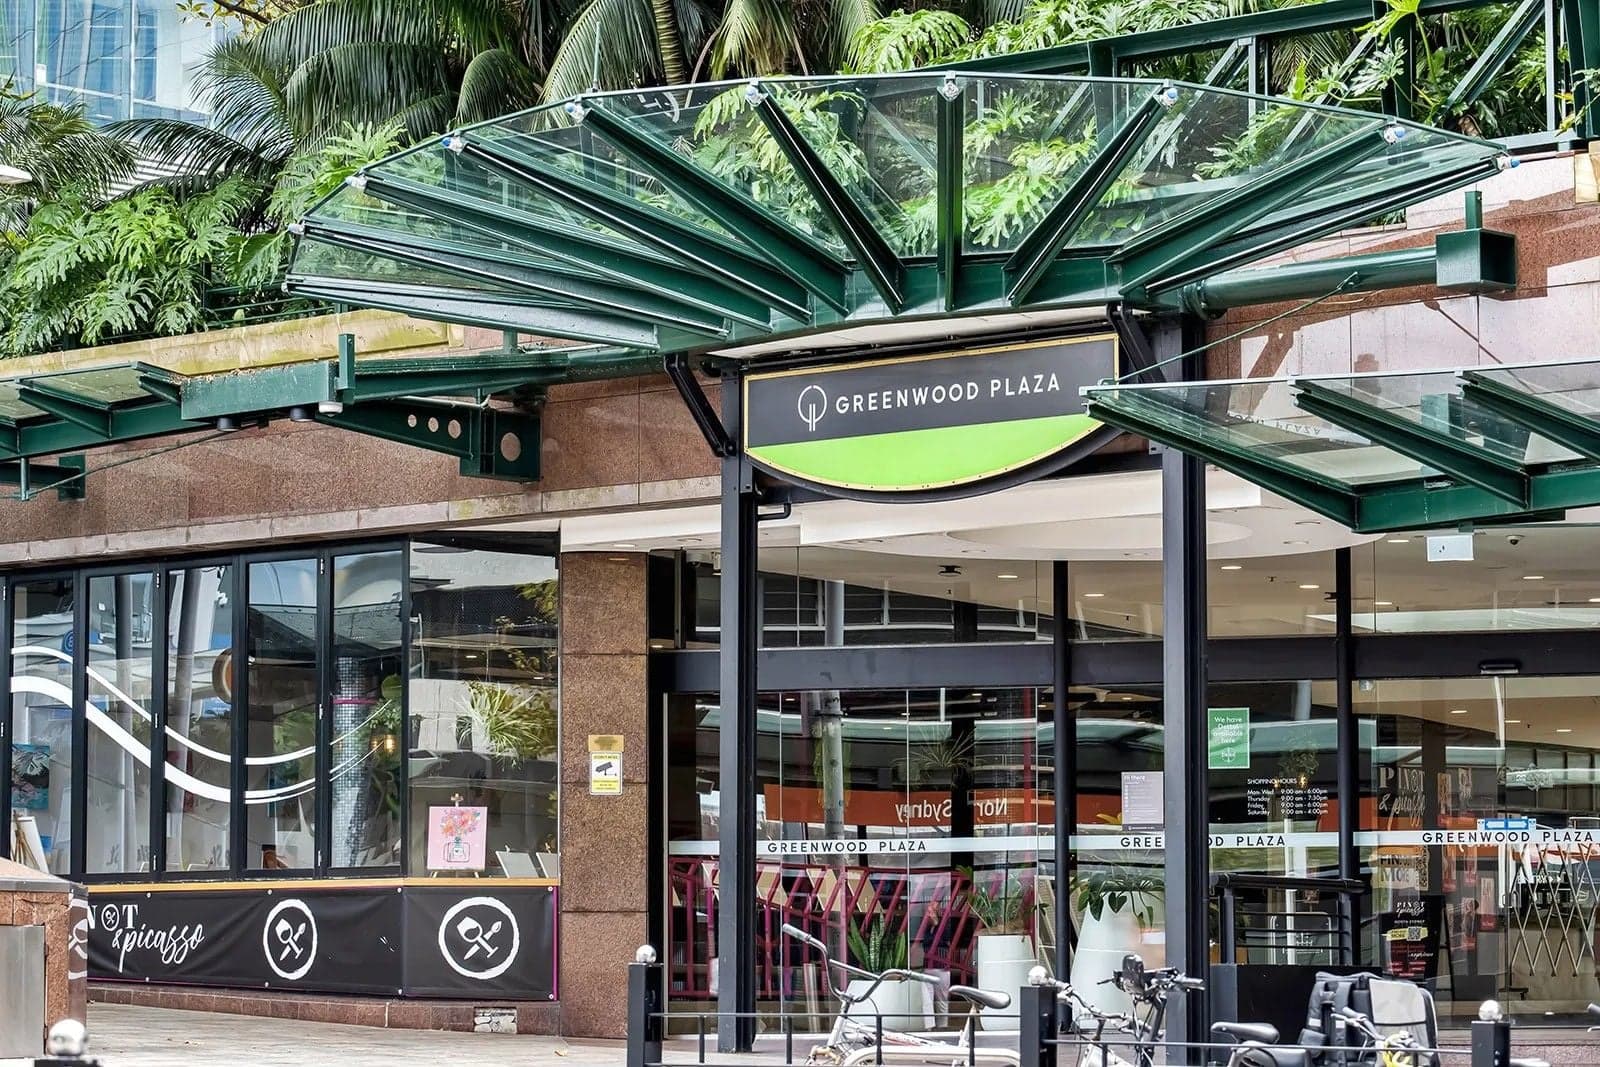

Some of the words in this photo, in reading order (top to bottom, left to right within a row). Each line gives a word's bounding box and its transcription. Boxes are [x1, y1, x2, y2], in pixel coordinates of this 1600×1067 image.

[836, 382, 979, 414] GREENWOOD
[990, 373, 1060, 398] PLAZA
[1247, 802, 1265, 810] Friday
[1236, 835, 1286, 847] PLAZA
[1422, 831, 1530, 843] GREENWOOD
[1542, 831, 1593, 842] PLAZA
[768, 841, 867, 853] GREENWOOD
[879, 840, 926, 851] PLAZA
